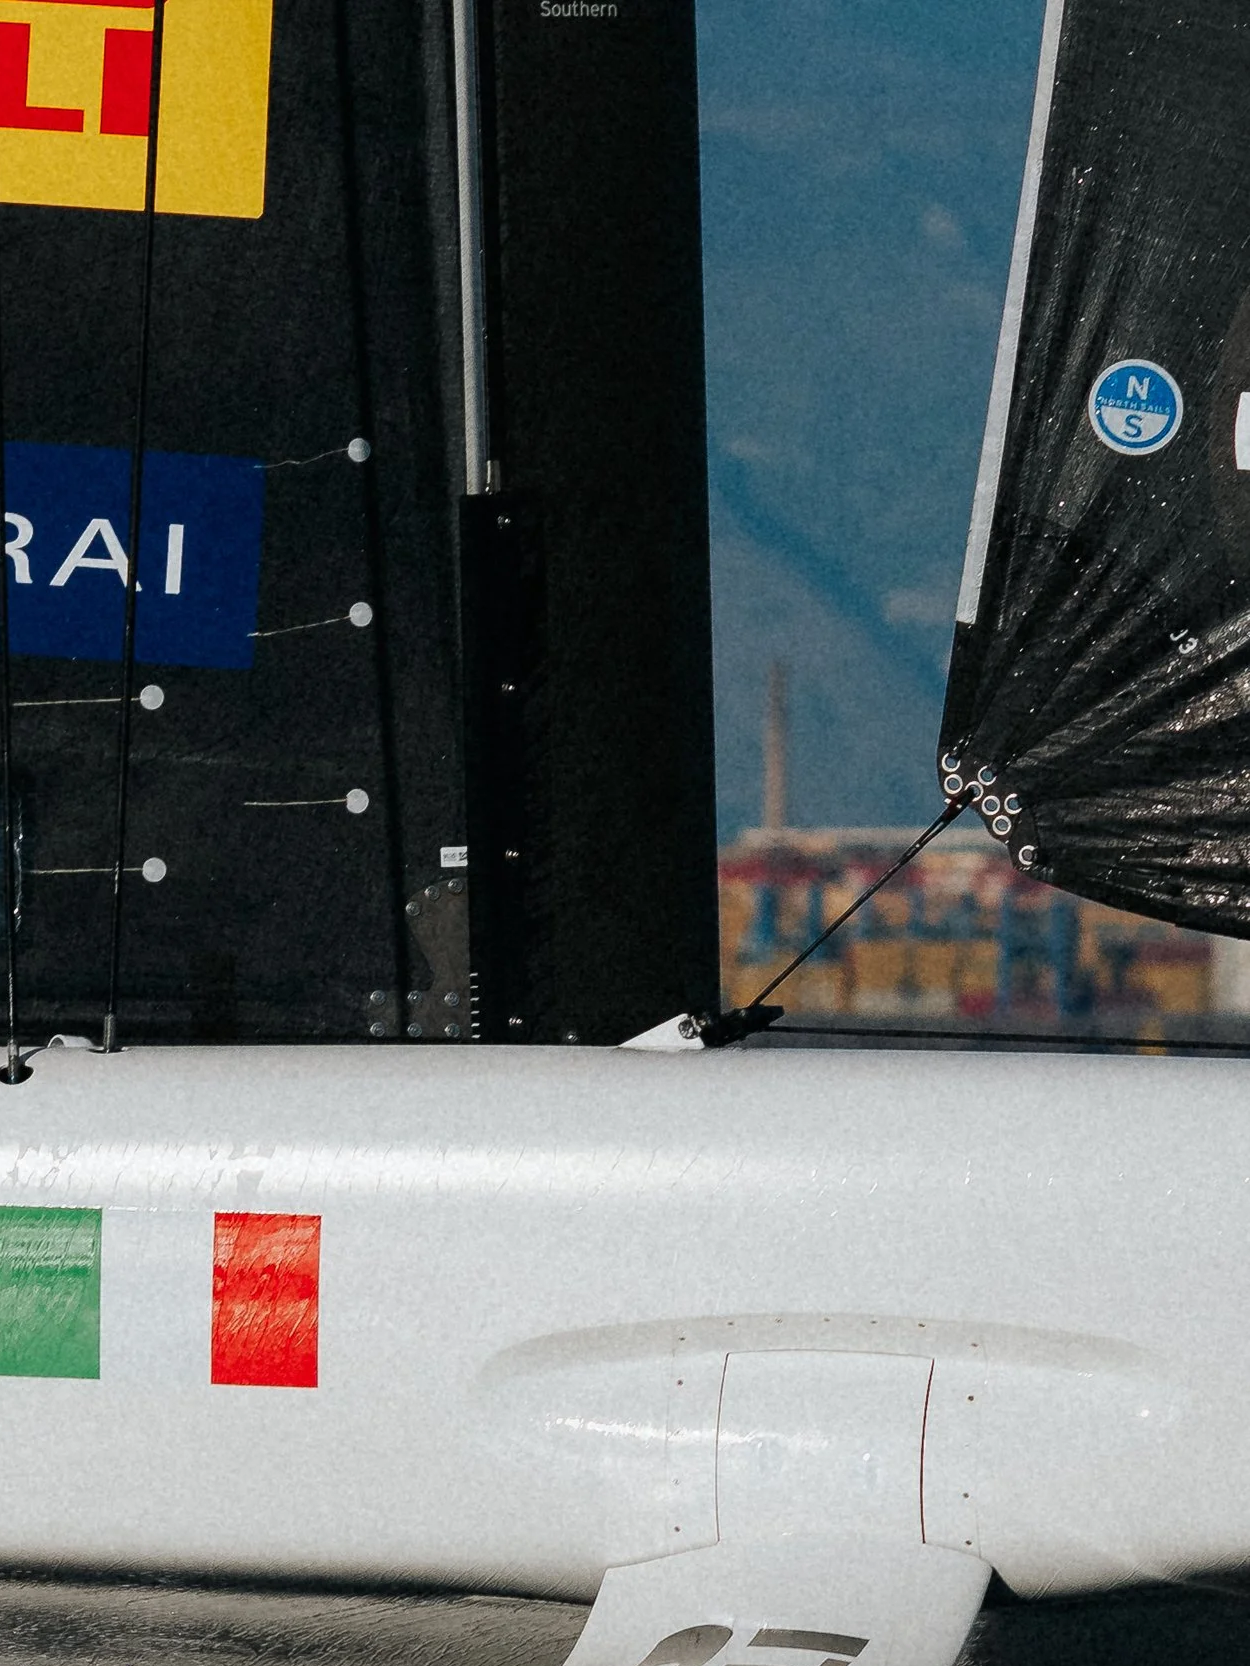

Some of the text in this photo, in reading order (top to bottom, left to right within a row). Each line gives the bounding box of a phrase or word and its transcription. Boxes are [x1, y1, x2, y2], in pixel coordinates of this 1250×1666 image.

[540, 0, 618, 17] Southern
[1126, 375, 1150, 400] N
[1100, 398, 1171, 415] NORTH SAILS
[1123, 414, 1143, 438] S
